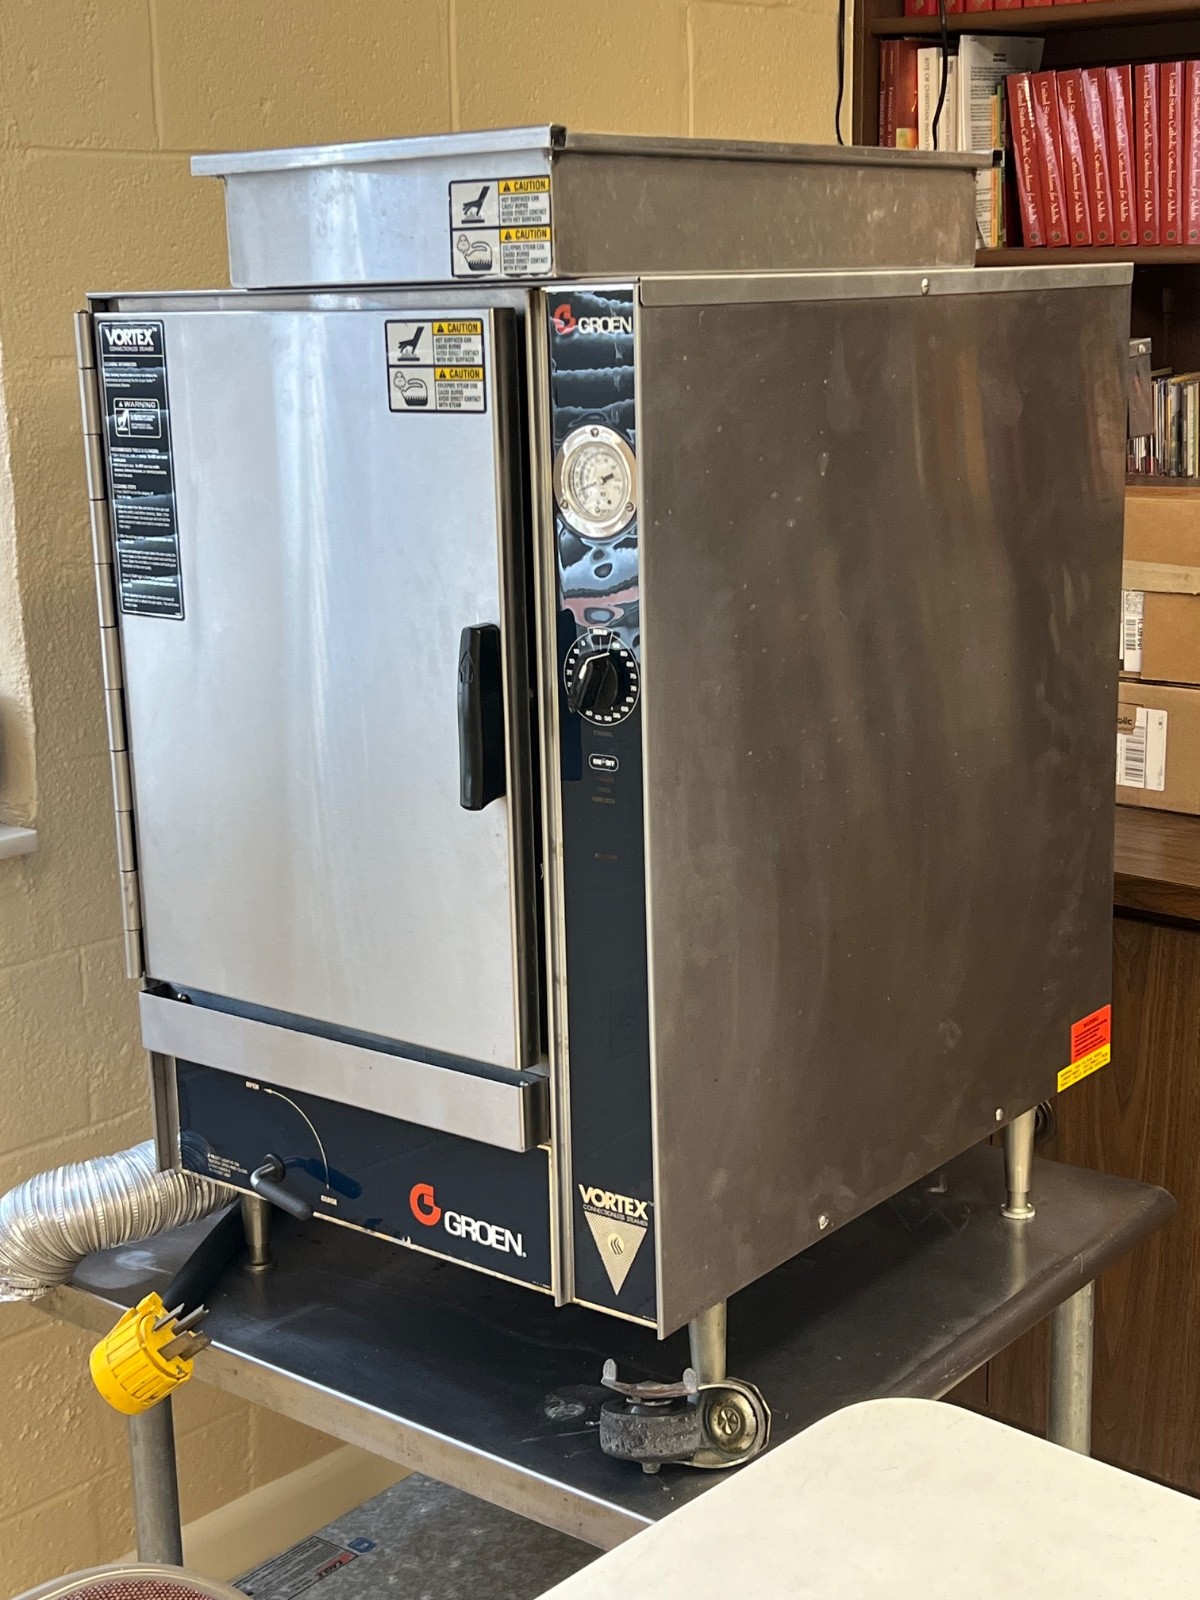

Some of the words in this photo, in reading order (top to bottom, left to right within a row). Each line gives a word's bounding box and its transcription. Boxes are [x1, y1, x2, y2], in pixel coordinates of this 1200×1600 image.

[1017, 83, 1027, 106] United
[1066, 79, 1075, 104] United
[1143, 74, 1152, 99] United
[1168, 72, 1177, 97] United
[1019, 106, 1027, 128] States
[1143, 99, 1151, 122] States
[1021, 127, 1031, 156] Catholic
[1143, 122, 1152, 152] Catholic
[1168, 120, 1176, 150] Catholic
[1041, 81, 1050, 104] United
[1050, 202, 1059, 223] Adults
[1024, 156, 1033, 192] Catechism
[1071, 155, 1081, 190] Catechism
[1095, 154, 1103, 189] Catechism
[1118, 152, 1127, 189] Catechism
[1144, 152, 1153, 189] Catechism
[1167, 150, 1176, 187] Catechism
[513, 180, 546, 192] CAUTION
[1028, 202, 1037, 224] Adults
[1075, 202, 1083, 223] Adults
[1098, 201, 1106, 222] Adults
[1120, 200, 1128, 222] Adults
[1144, 200, 1153, 222] Adults
[1167, 199, 1176, 222] Adults
[515, 229, 548, 240] CAUTION
[447, 322, 478, 333] CAUTION
[578, 316, 633, 334] GROEN
[104, 328, 154, 346] VORTEX
[449, 369, 480, 379] CAUTION
[579, 1184, 648, 1220] VORTEX
